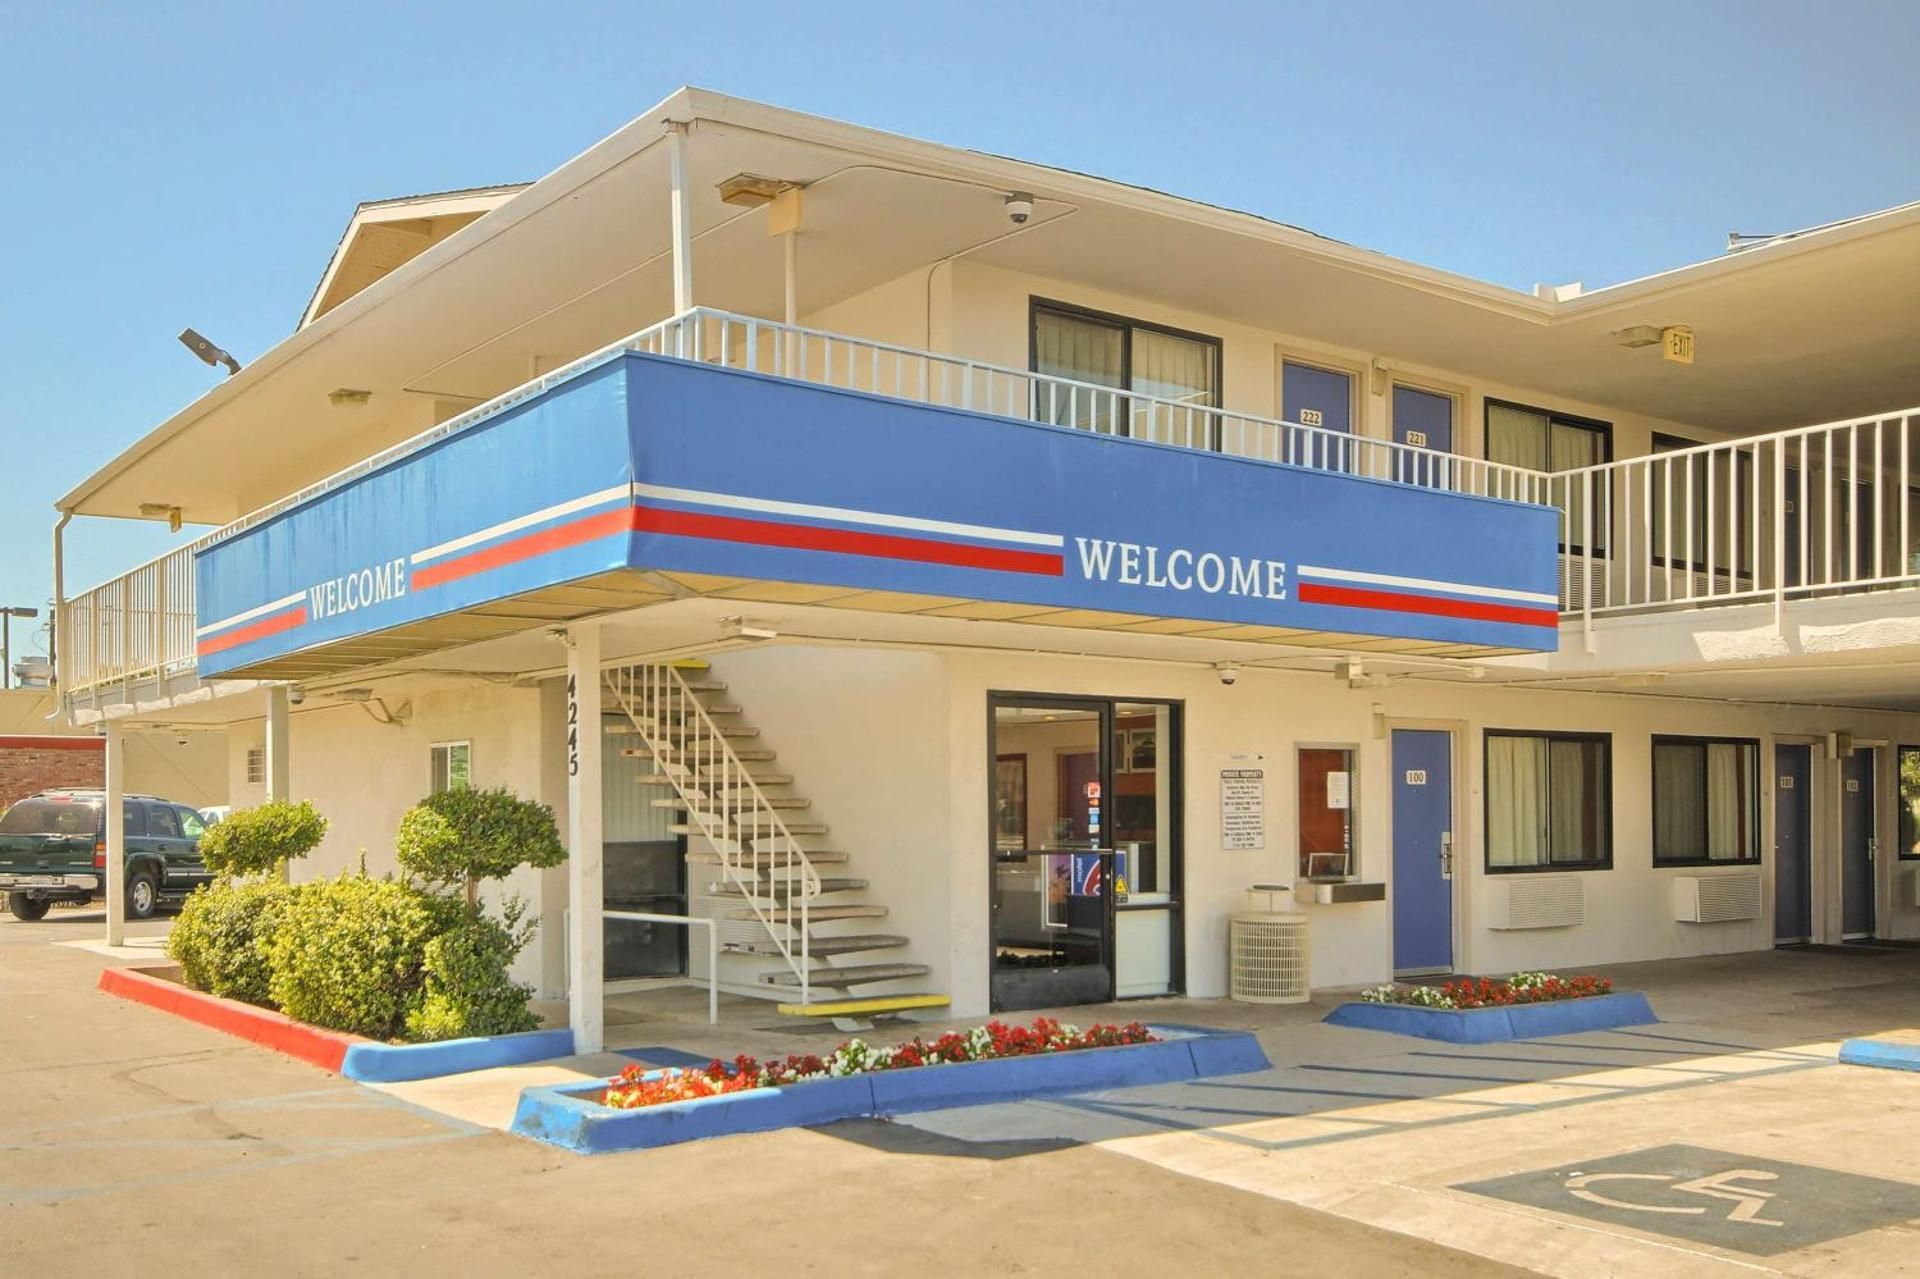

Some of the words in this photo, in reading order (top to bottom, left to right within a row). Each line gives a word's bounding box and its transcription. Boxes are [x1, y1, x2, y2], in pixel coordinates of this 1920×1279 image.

[1673, 333, 1691, 357] EXIT
[1303, 411, 1320, 424] 222
[1409, 432, 1424, 445] 221
[1075, 537, 1287, 600] WELCOME
[309, 558, 406, 622] WELCOME
[567, 673, 579, 777] 4245
[1409, 772, 1423, 782] 100
